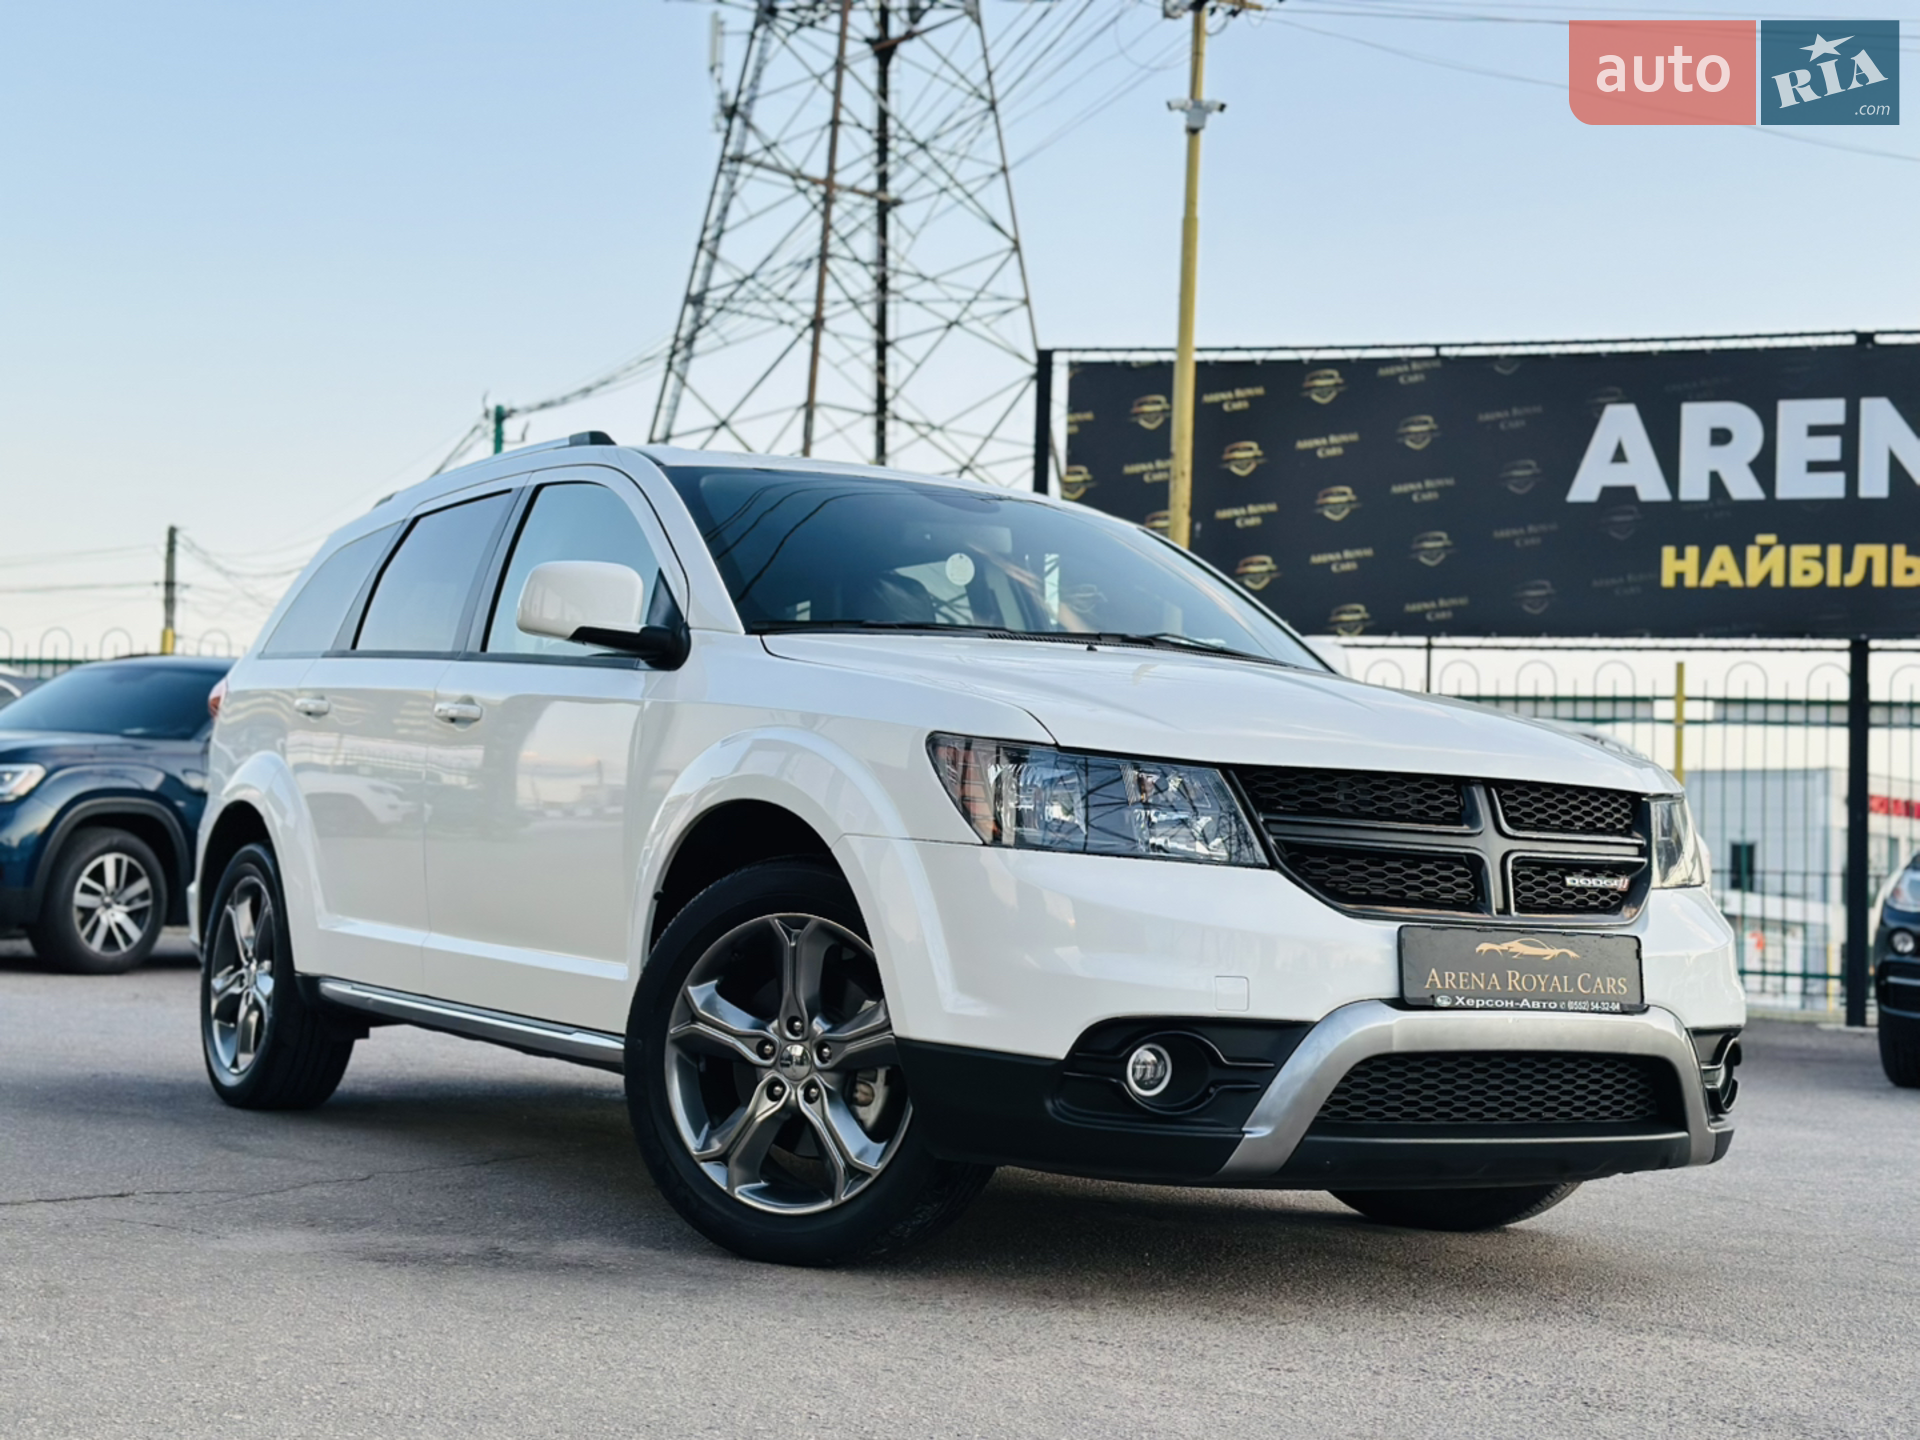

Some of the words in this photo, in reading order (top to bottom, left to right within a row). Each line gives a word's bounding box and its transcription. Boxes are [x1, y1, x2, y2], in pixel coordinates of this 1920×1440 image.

[1566, 397, 1920, 502] AREN
[1660, 533, 1920, 588] НАЙБІЛЬ
[1565, 876, 1618, 888] DODGE
[1424, 967, 1501, 990] ARENA
[1507, 970, 1574, 993] ROYAL
[1577, 973, 1628, 995] CARS
[1454, 995, 1557, 1009] Херсон-Авто
